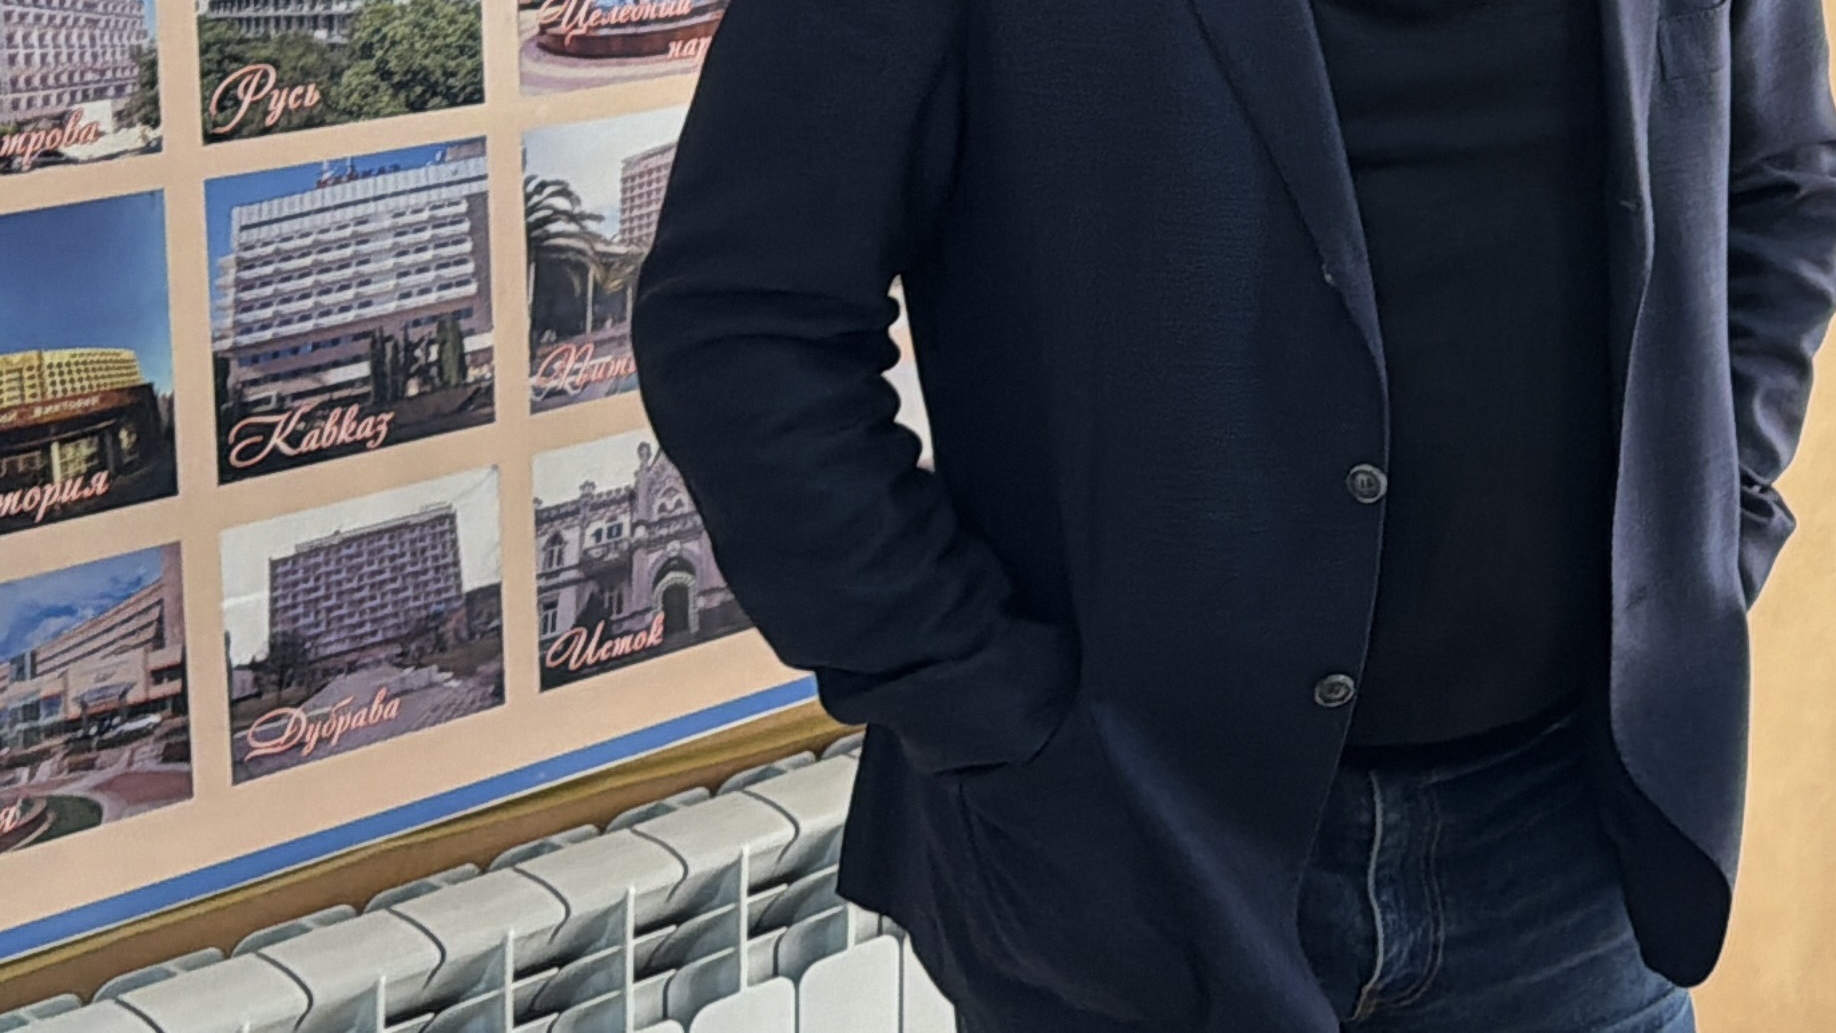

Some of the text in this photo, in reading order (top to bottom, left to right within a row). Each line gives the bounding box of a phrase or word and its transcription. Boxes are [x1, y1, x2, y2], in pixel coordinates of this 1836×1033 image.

[667, 36, 712, 64] нар
[210, 63, 321, 134] Русь
[228, 403, 395, 468] Кавказ
[545, 610, 665, 672] Исток
[244, 686, 401, 762] Дубрава
